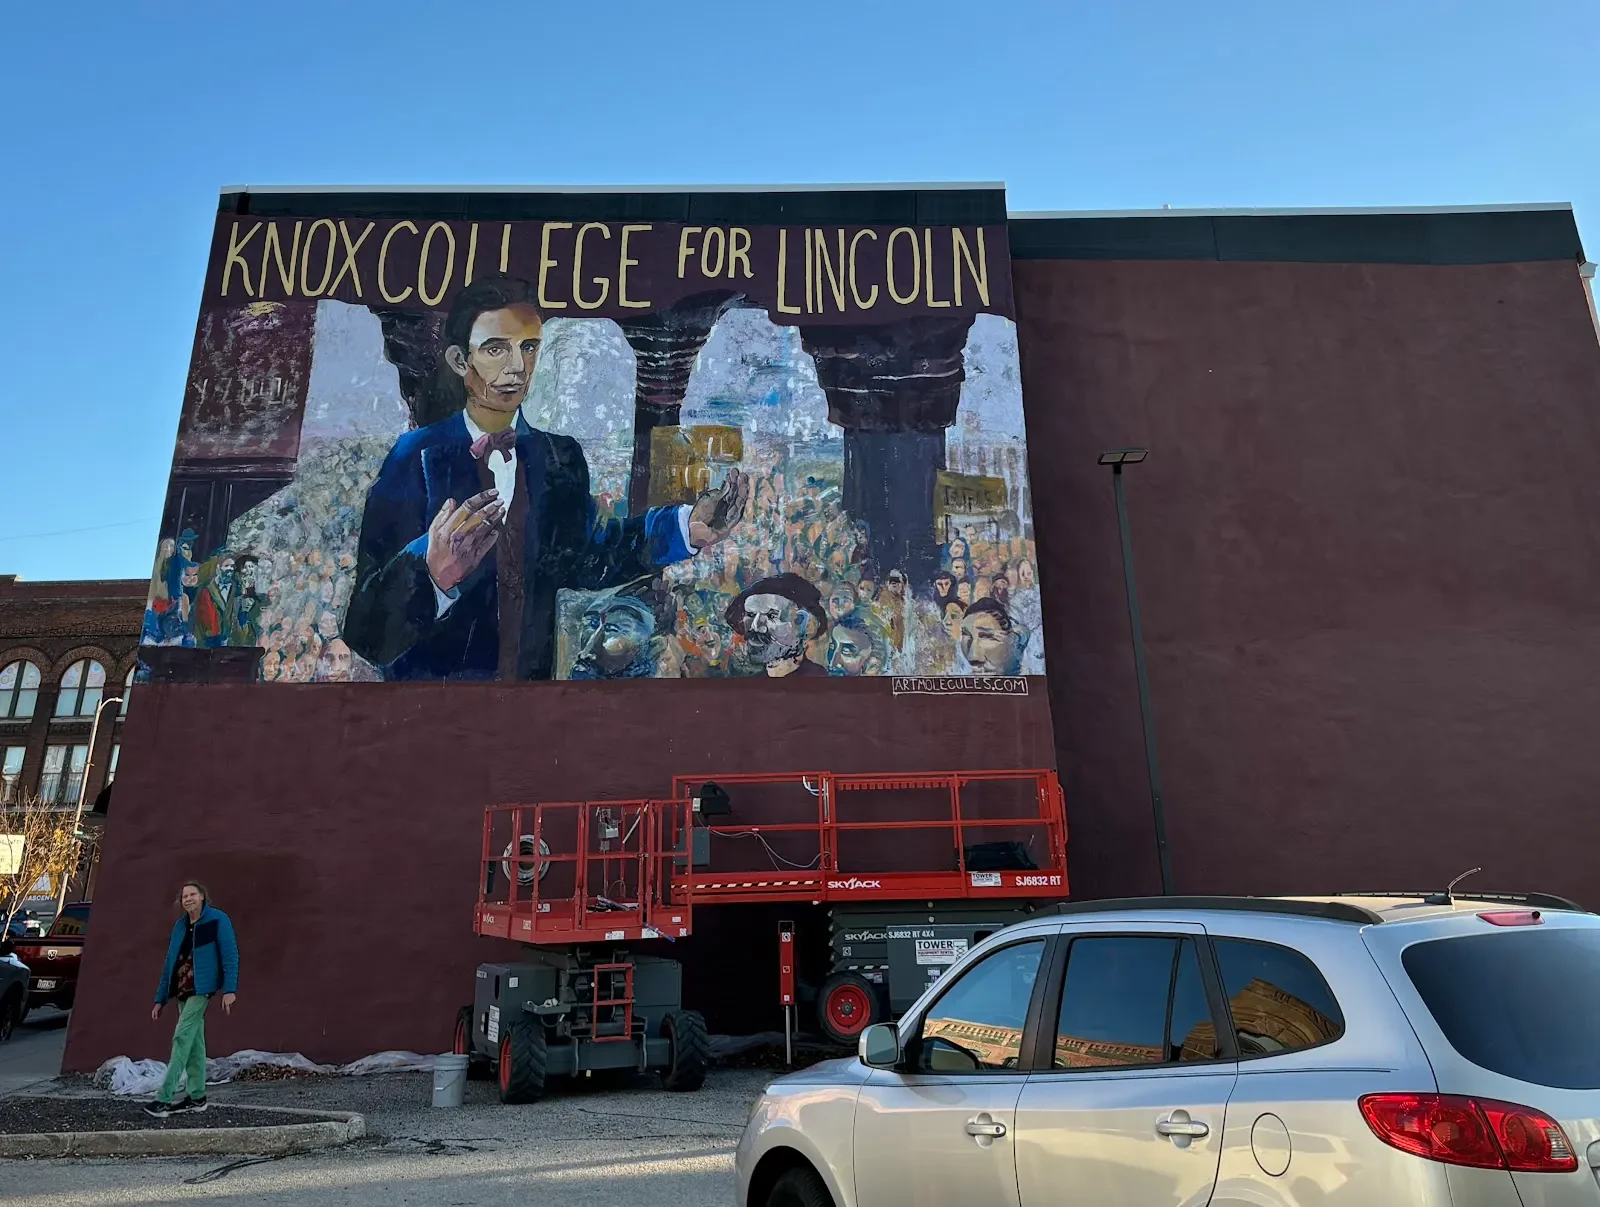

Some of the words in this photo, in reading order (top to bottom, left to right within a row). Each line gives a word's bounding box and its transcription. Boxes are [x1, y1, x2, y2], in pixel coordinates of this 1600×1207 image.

[221, 218, 374, 298] KNOX
[678, 226, 755, 278] FOR
[777, 226, 990, 315] LINCOLN
[894, 677, 1026, 693] ARTMOLECULES.COM
[827, 877, 882, 890] SKYJACK
[1015, 876, 1049, 886] SJ6832
[1050, 876, 1062, 886] RT
[844, 930, 888, 941] SKYJACK
[888, 931, 912, 939] SJ6832
[912, 930, 921, 938] RT
[921, 930, 935, 938] 4X4
[917, 940, 954, 949] TOWER
